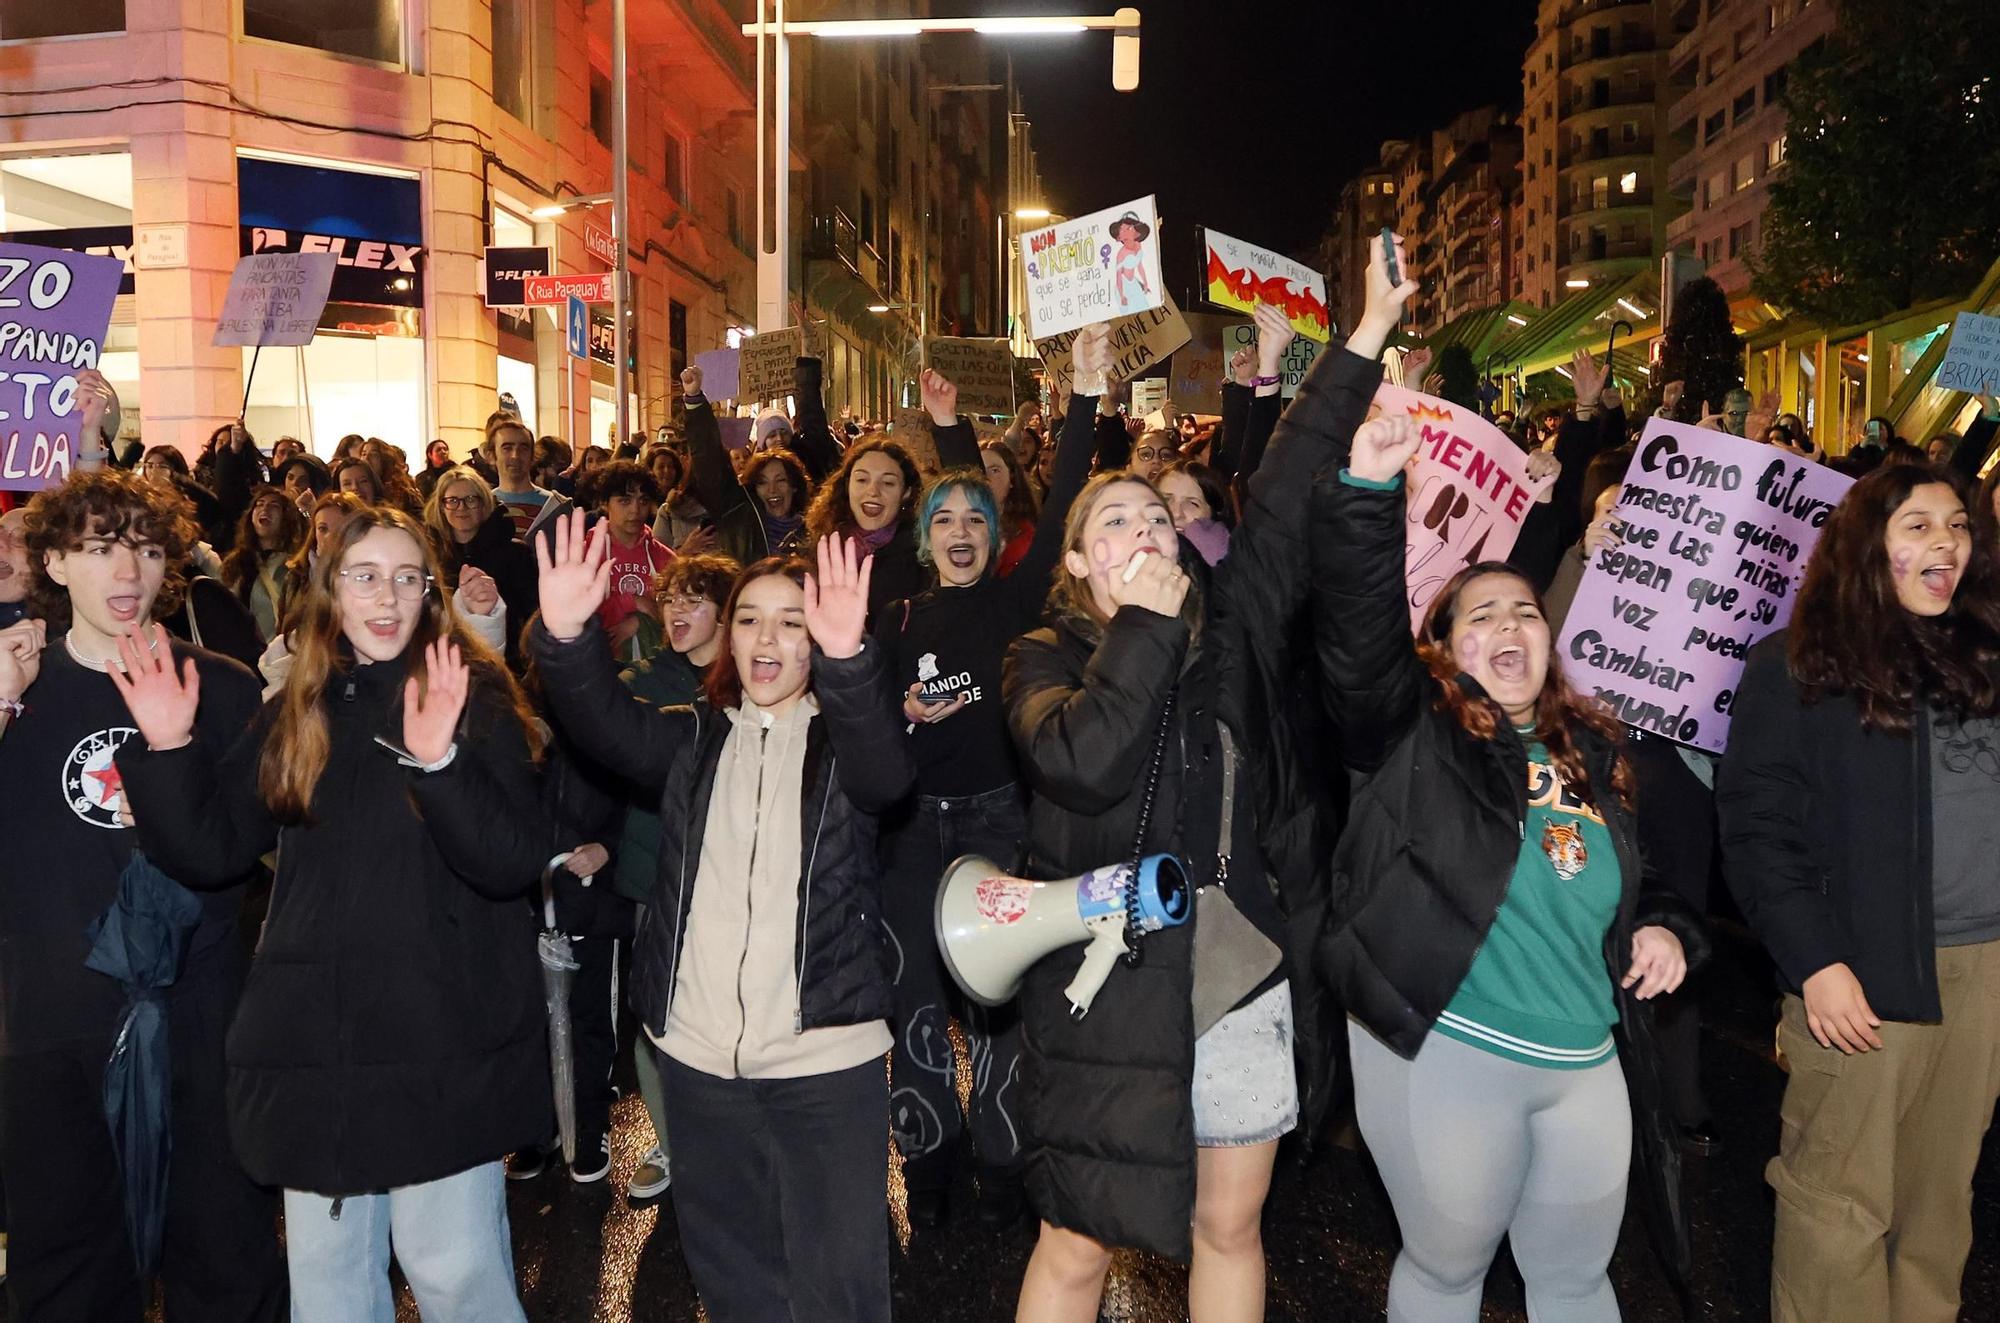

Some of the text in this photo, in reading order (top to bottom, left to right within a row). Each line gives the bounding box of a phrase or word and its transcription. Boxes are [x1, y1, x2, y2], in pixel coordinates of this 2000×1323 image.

[300, 234, 422, 273] FLEX
[1030, 223, 1100, 255] NON son un
[1038, 236, 1096, 280] PREMIO
[536, 281, 599, 300] Rúa Paraguay
[1036, 267, 1102, 300] que se gana
[1060, 299, 1073, 317] se
[1151, 304, 1173, 326] LA
[1420, 424, 1531, 523] MENTE
[1641, 434, 1742, 491] Como
[1620, 483, 1799, 563] maestra quiero
[1596, 547, 1673, 593] sepan
[1750, 599, 1777, 626] su
[1612, 595, 1754, 662] voz pued
[1570, 629, 1695, 693] Cambiar
